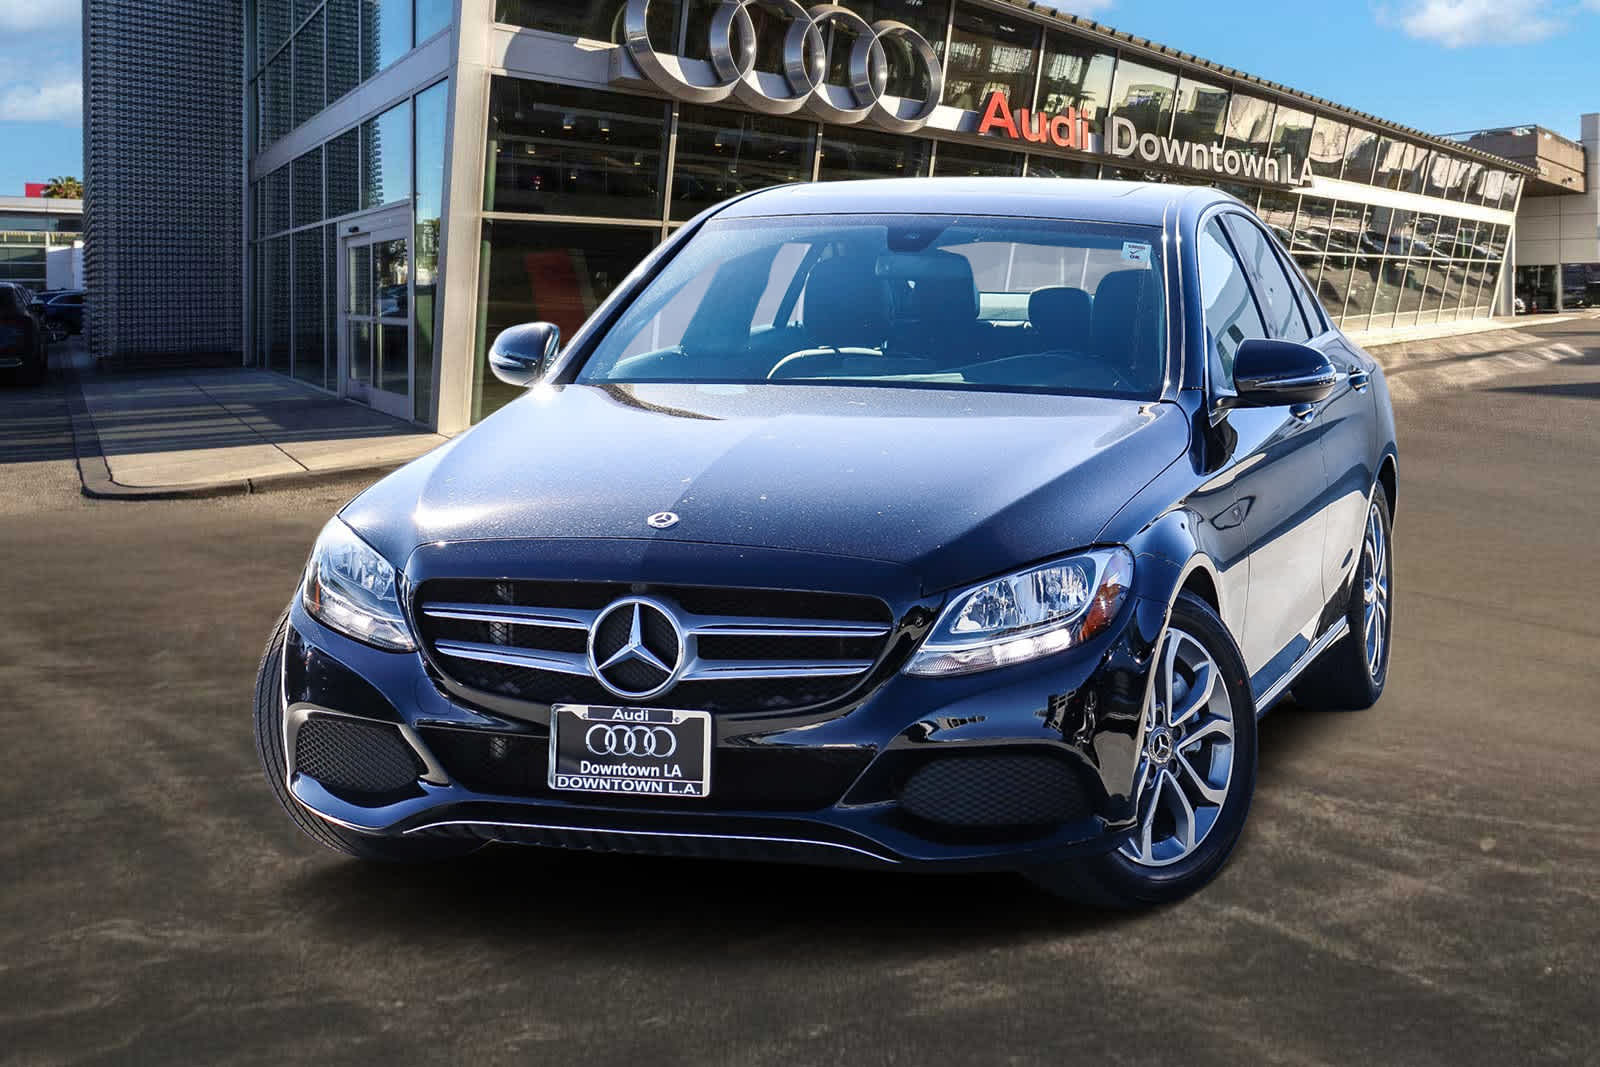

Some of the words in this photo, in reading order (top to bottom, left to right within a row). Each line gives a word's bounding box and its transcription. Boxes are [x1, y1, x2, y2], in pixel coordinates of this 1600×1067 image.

[978, 91, 1089, 151] Audi
[1105, 115, 1280, 184] Downtown
[1281, 154, 1315, 188] LA
[612, 708, 649, 722] Audi
[580, 760, 660, 777] Downtown
[664, 764, 682, 778] LA
[557, 776, 663, 793] DOWNTOWN
[668, 783, 701, 795] L.A.
